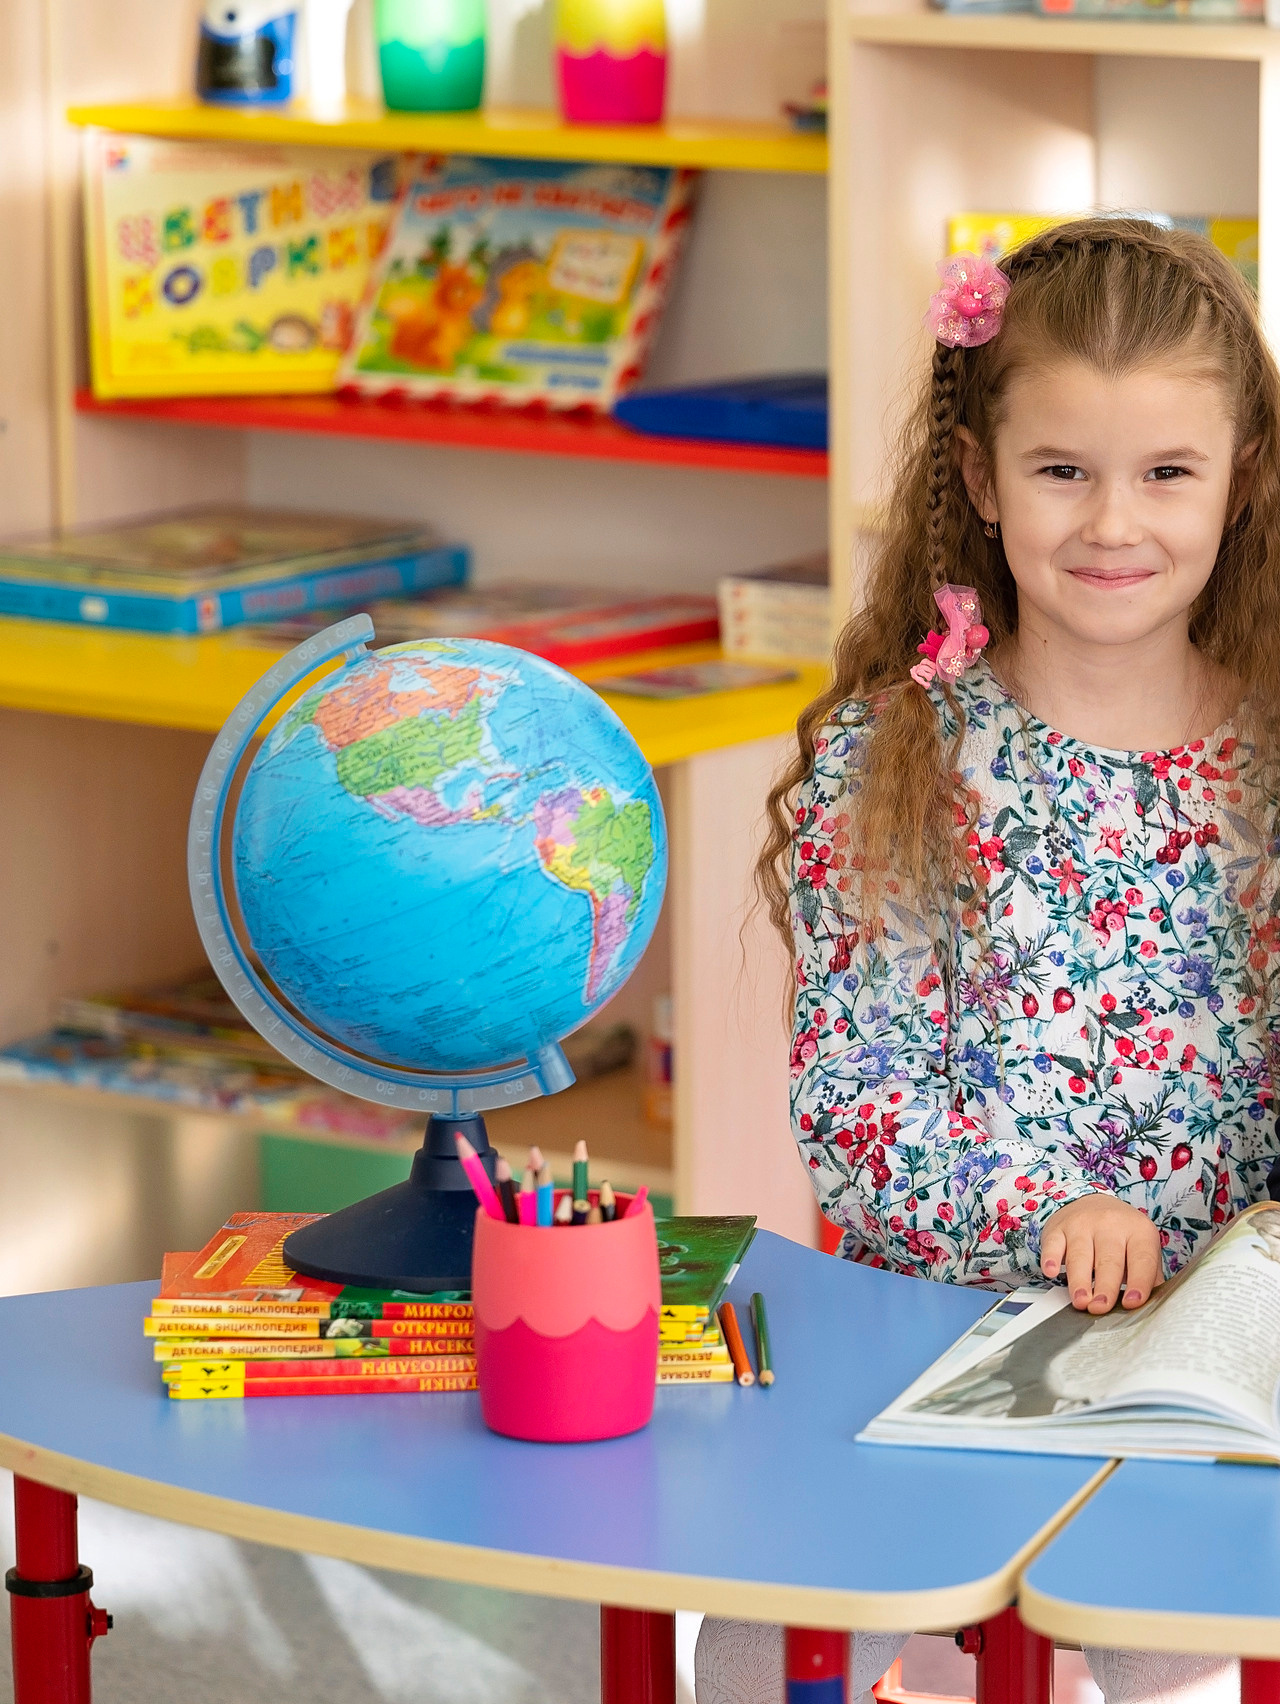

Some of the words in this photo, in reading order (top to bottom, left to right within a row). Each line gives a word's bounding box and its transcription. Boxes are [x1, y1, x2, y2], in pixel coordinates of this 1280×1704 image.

[172, 1304, 223, 1315] ДЕТСКАЯ
[228, 1304, 321, 1315] ЭНЦИКЛОПЕДИЯ
[404, 1304, 474, 1319] МИКРО
[158, 1322, 210, 1333] ДЕТСКАЯ
[215, 1321, 308, 1333] ЭНЦИКЛОПЕДИЯ
[392, 1322, 475, 1336] ОТКРЫТИ
[171, 1346, 223, 1358] ДЕТСКАЯ
[229, 1343, 324, 1356] ЭНЦИКЛОПЕДИЯ
[661, 1351, 714, 1362] ДЕТСКАЯ
[661, 1369, 713, 1380] ДЕТСКАЯ
[419, 1376, 480, 1392] ТАНКИ
